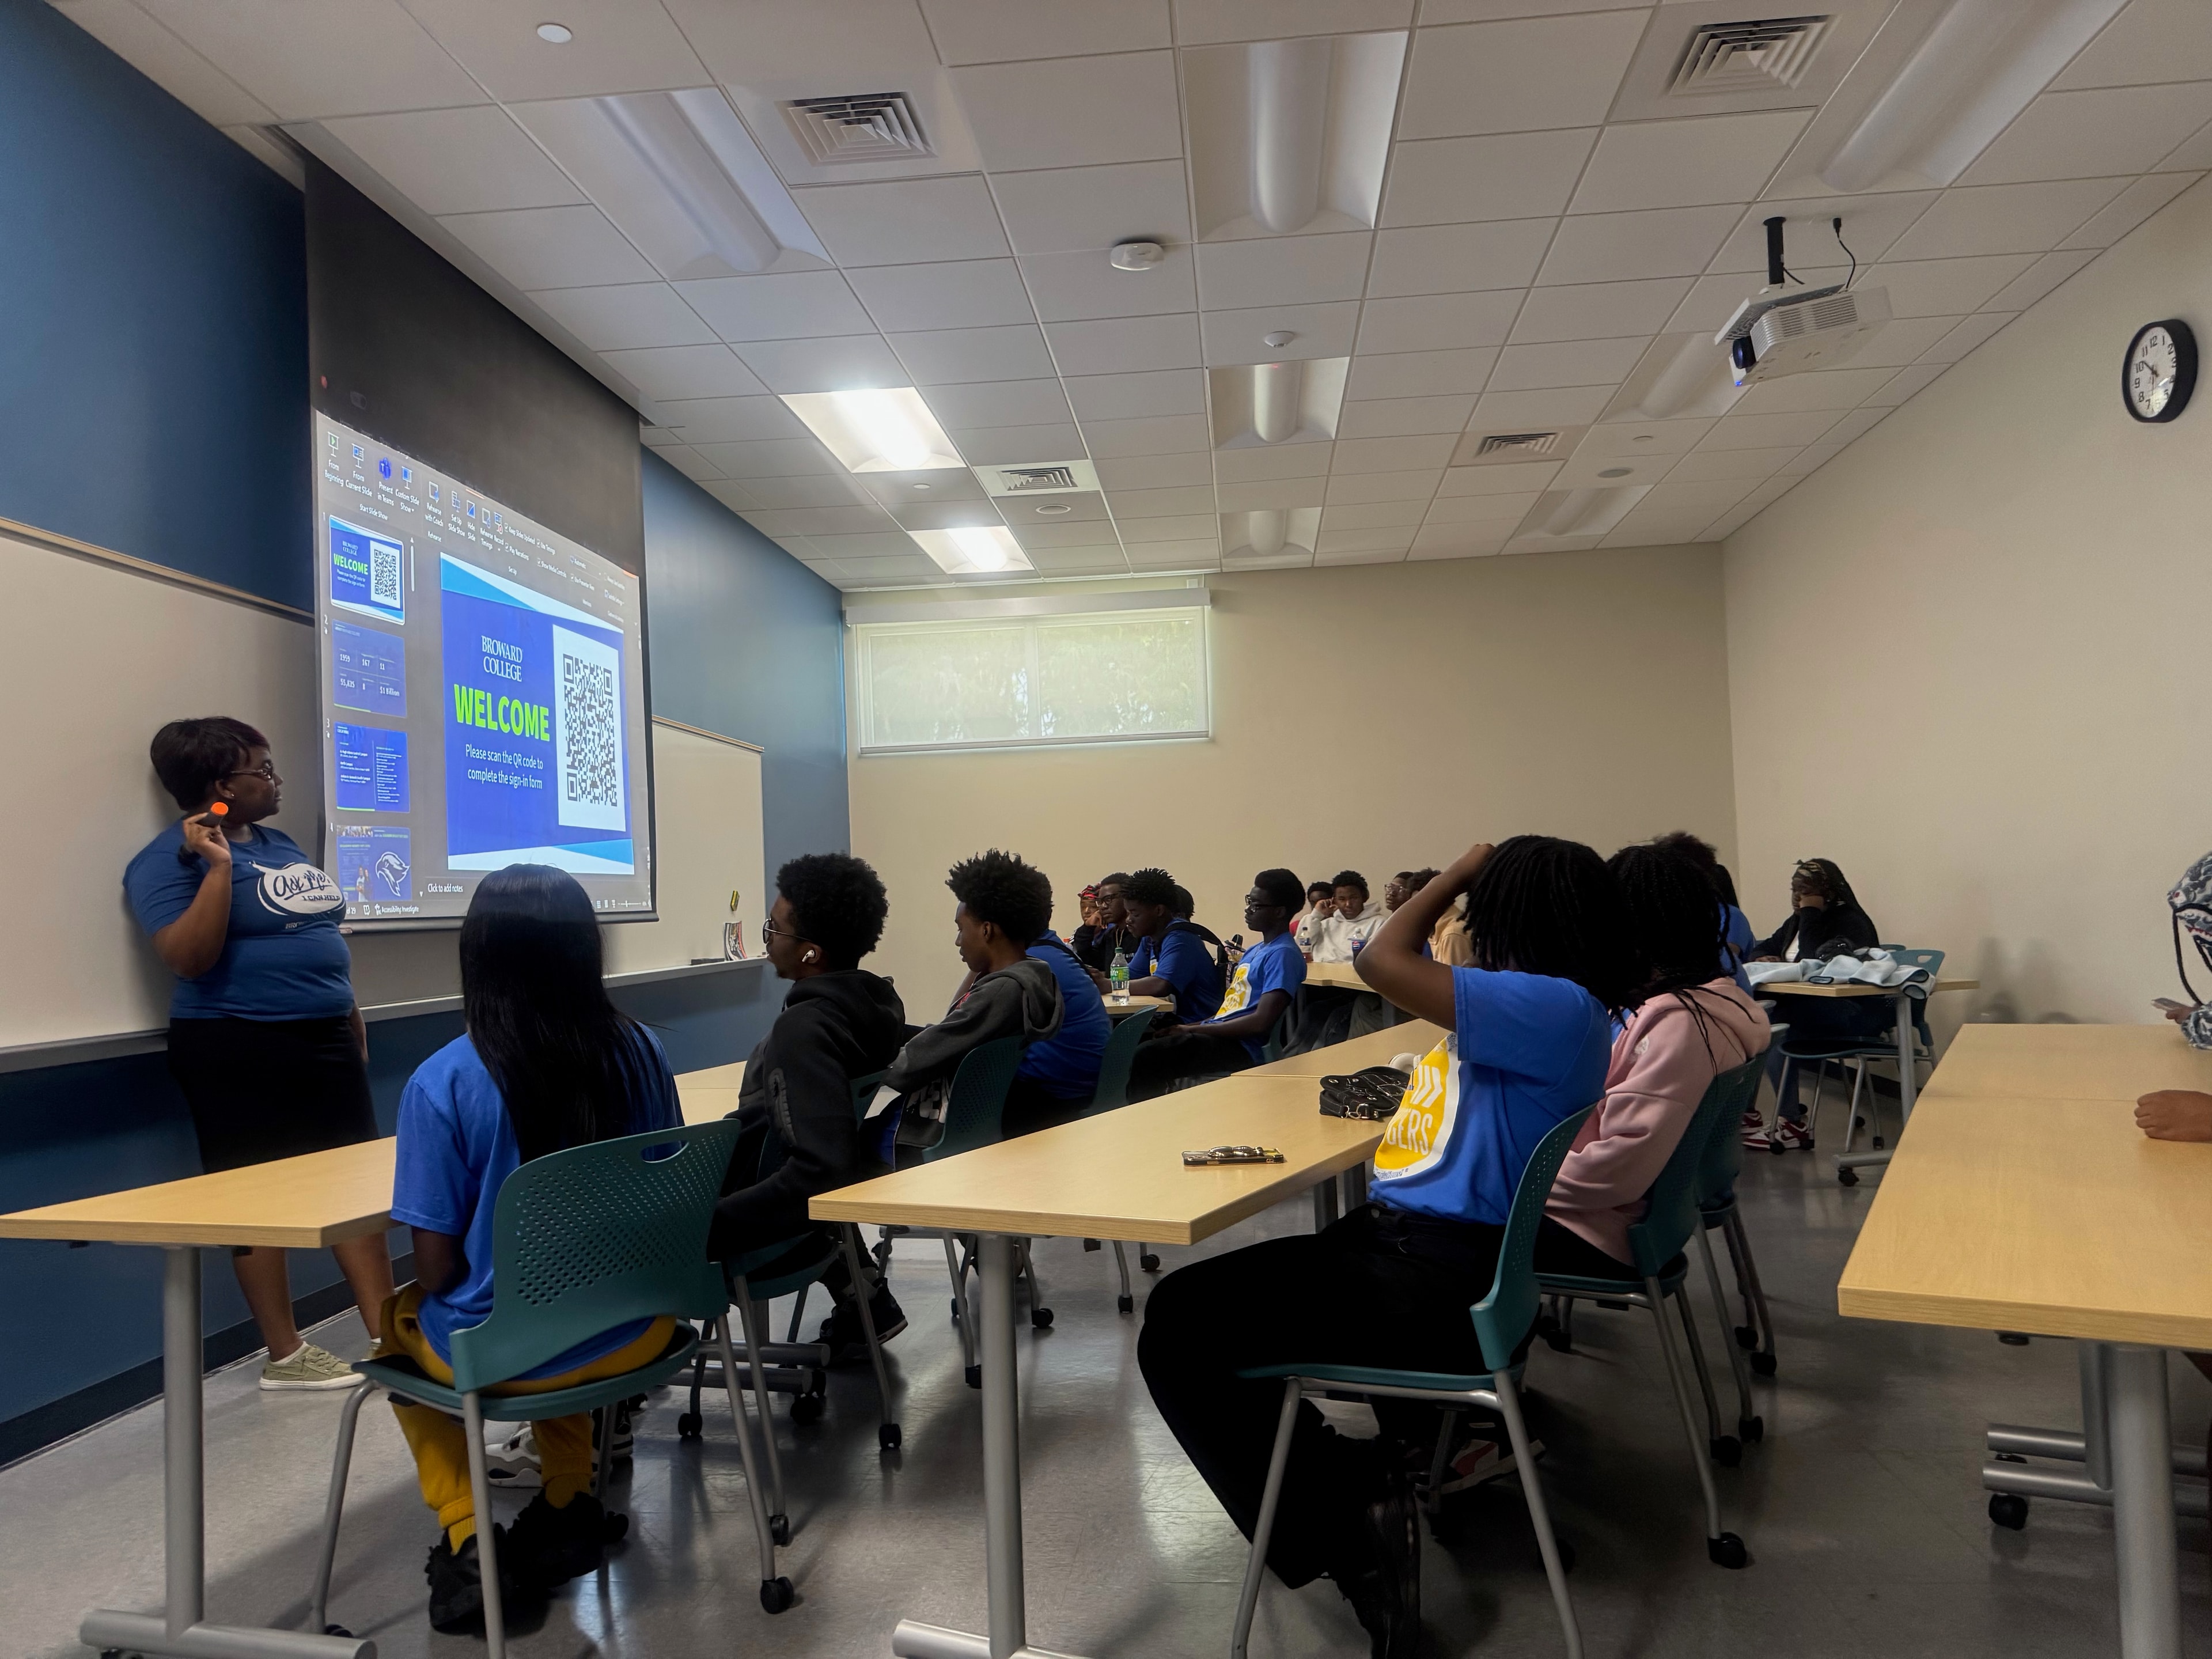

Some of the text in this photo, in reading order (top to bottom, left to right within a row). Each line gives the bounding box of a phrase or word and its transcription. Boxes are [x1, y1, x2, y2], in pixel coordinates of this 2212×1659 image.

[2150, 336, 2157, 348] 12
[2162, 336, 2165, 346] 1
[2142, 346, 2148, 357] 11
[2168, 343, 2174, 355] 2
[2135, 361, 2144, 373] 10
[2134, 377, 2140, 389] 9
[2139, 391, 2144, 403] 8
[2145, 399, 2150, 410] 7
[328, 459, 339, 471] From
[324, 469, 344, 487] Beginning
[353, 471, 365, 482] From
[346, 480, 373, 497] Current Slide
[378, 481, 393, 494] Present
[377, 493, 394, 506] in Teams
[395, 489, 419, 506] Custom Slide
[359, 503, 388, 520] Start Slide Show
[400, 502, 411, 513] Show
[334, 553, 368, 575] WELCOME
[324, 615, 328, 625] 2
[482, 635, 522, 663] BROWARD
[340, 654, 350, 662] 1959
[483, 656, 522, 682] COLLEGE
[454, 684, 550, 741] WELCOME
[327, 718, 329, 728] 3
[465, 744, 543, 770] Please scan the QR code to
[468, 767, 543, 789] complete the sign-in form
[427, 884, 438, 892] Click
[351, 907, 356, 915] 29
[402, 906, 419, 915] Investigate
